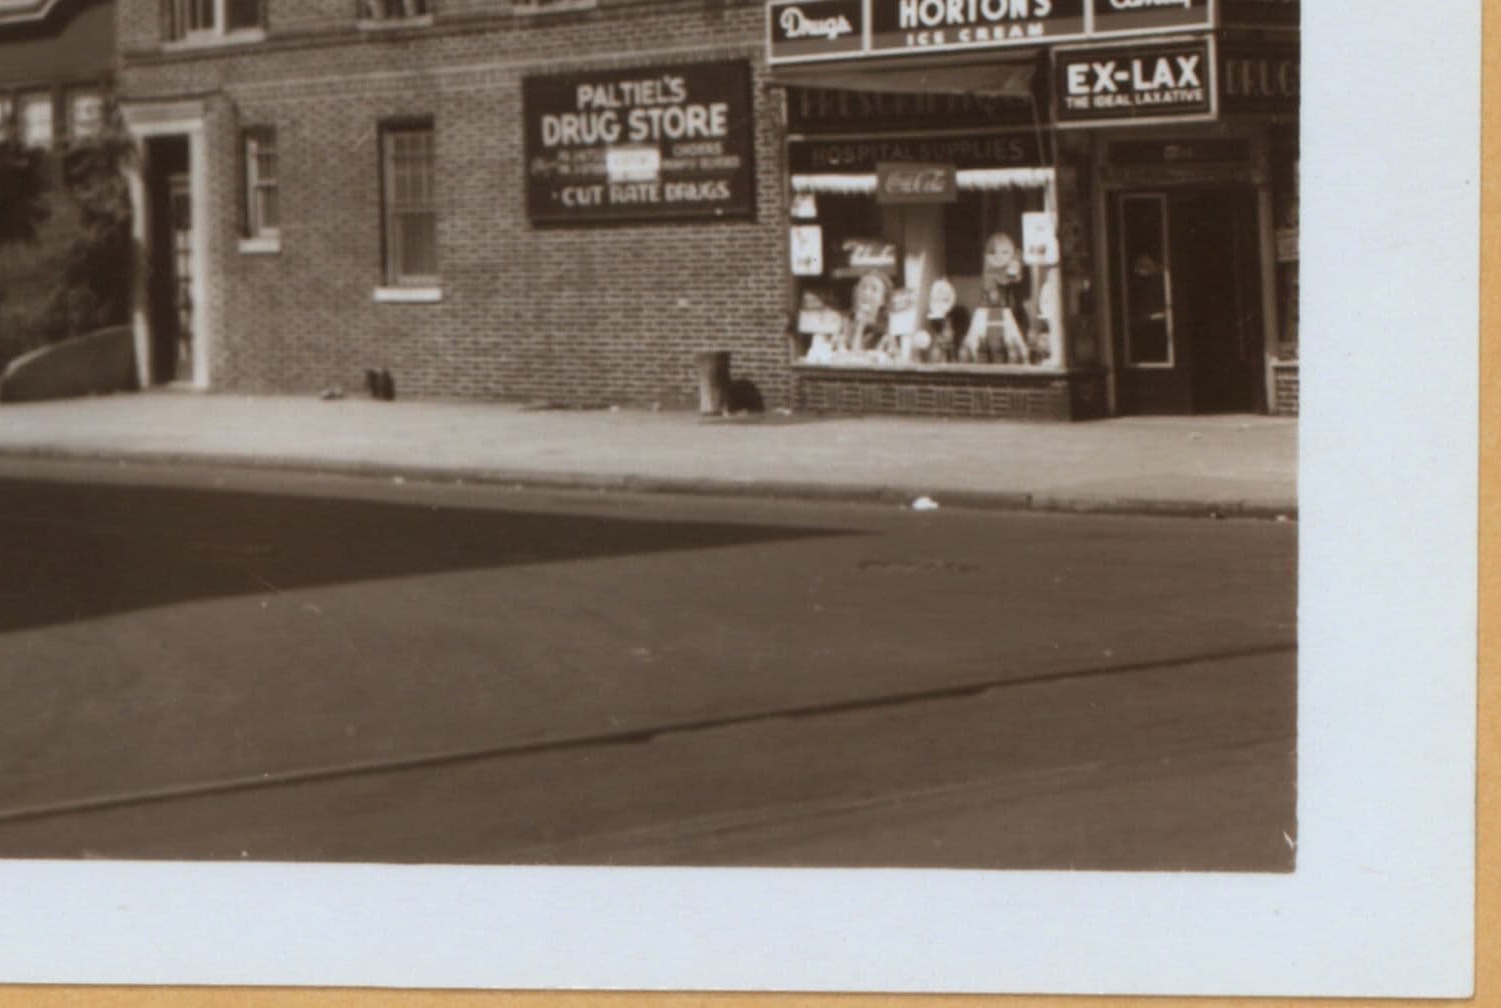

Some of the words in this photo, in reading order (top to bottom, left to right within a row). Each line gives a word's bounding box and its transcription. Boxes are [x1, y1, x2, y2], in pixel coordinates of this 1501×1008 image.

[780, 5, 852, 39] Drugs
[906, 30, 946, 47] ICE
[958, 22, 1045, 43] CREAM
[1066, 55, 1201, 95] EX-LAX
[576, 75, 687, 110] PALTIEL'S
[1065, 95, 1090, 109] THE
[1092, 93, 1133, 109] IDEAL
[1134, 87, 1204, 106] LAXATIVE
[541, 109, 622, 147] DRUG
[627, 102, 729, 142] STORE
[560, 185, 604, 207] CUT
[609, 180, 660, 205] RATE
[664, 179, 731, 202] DRUGS
